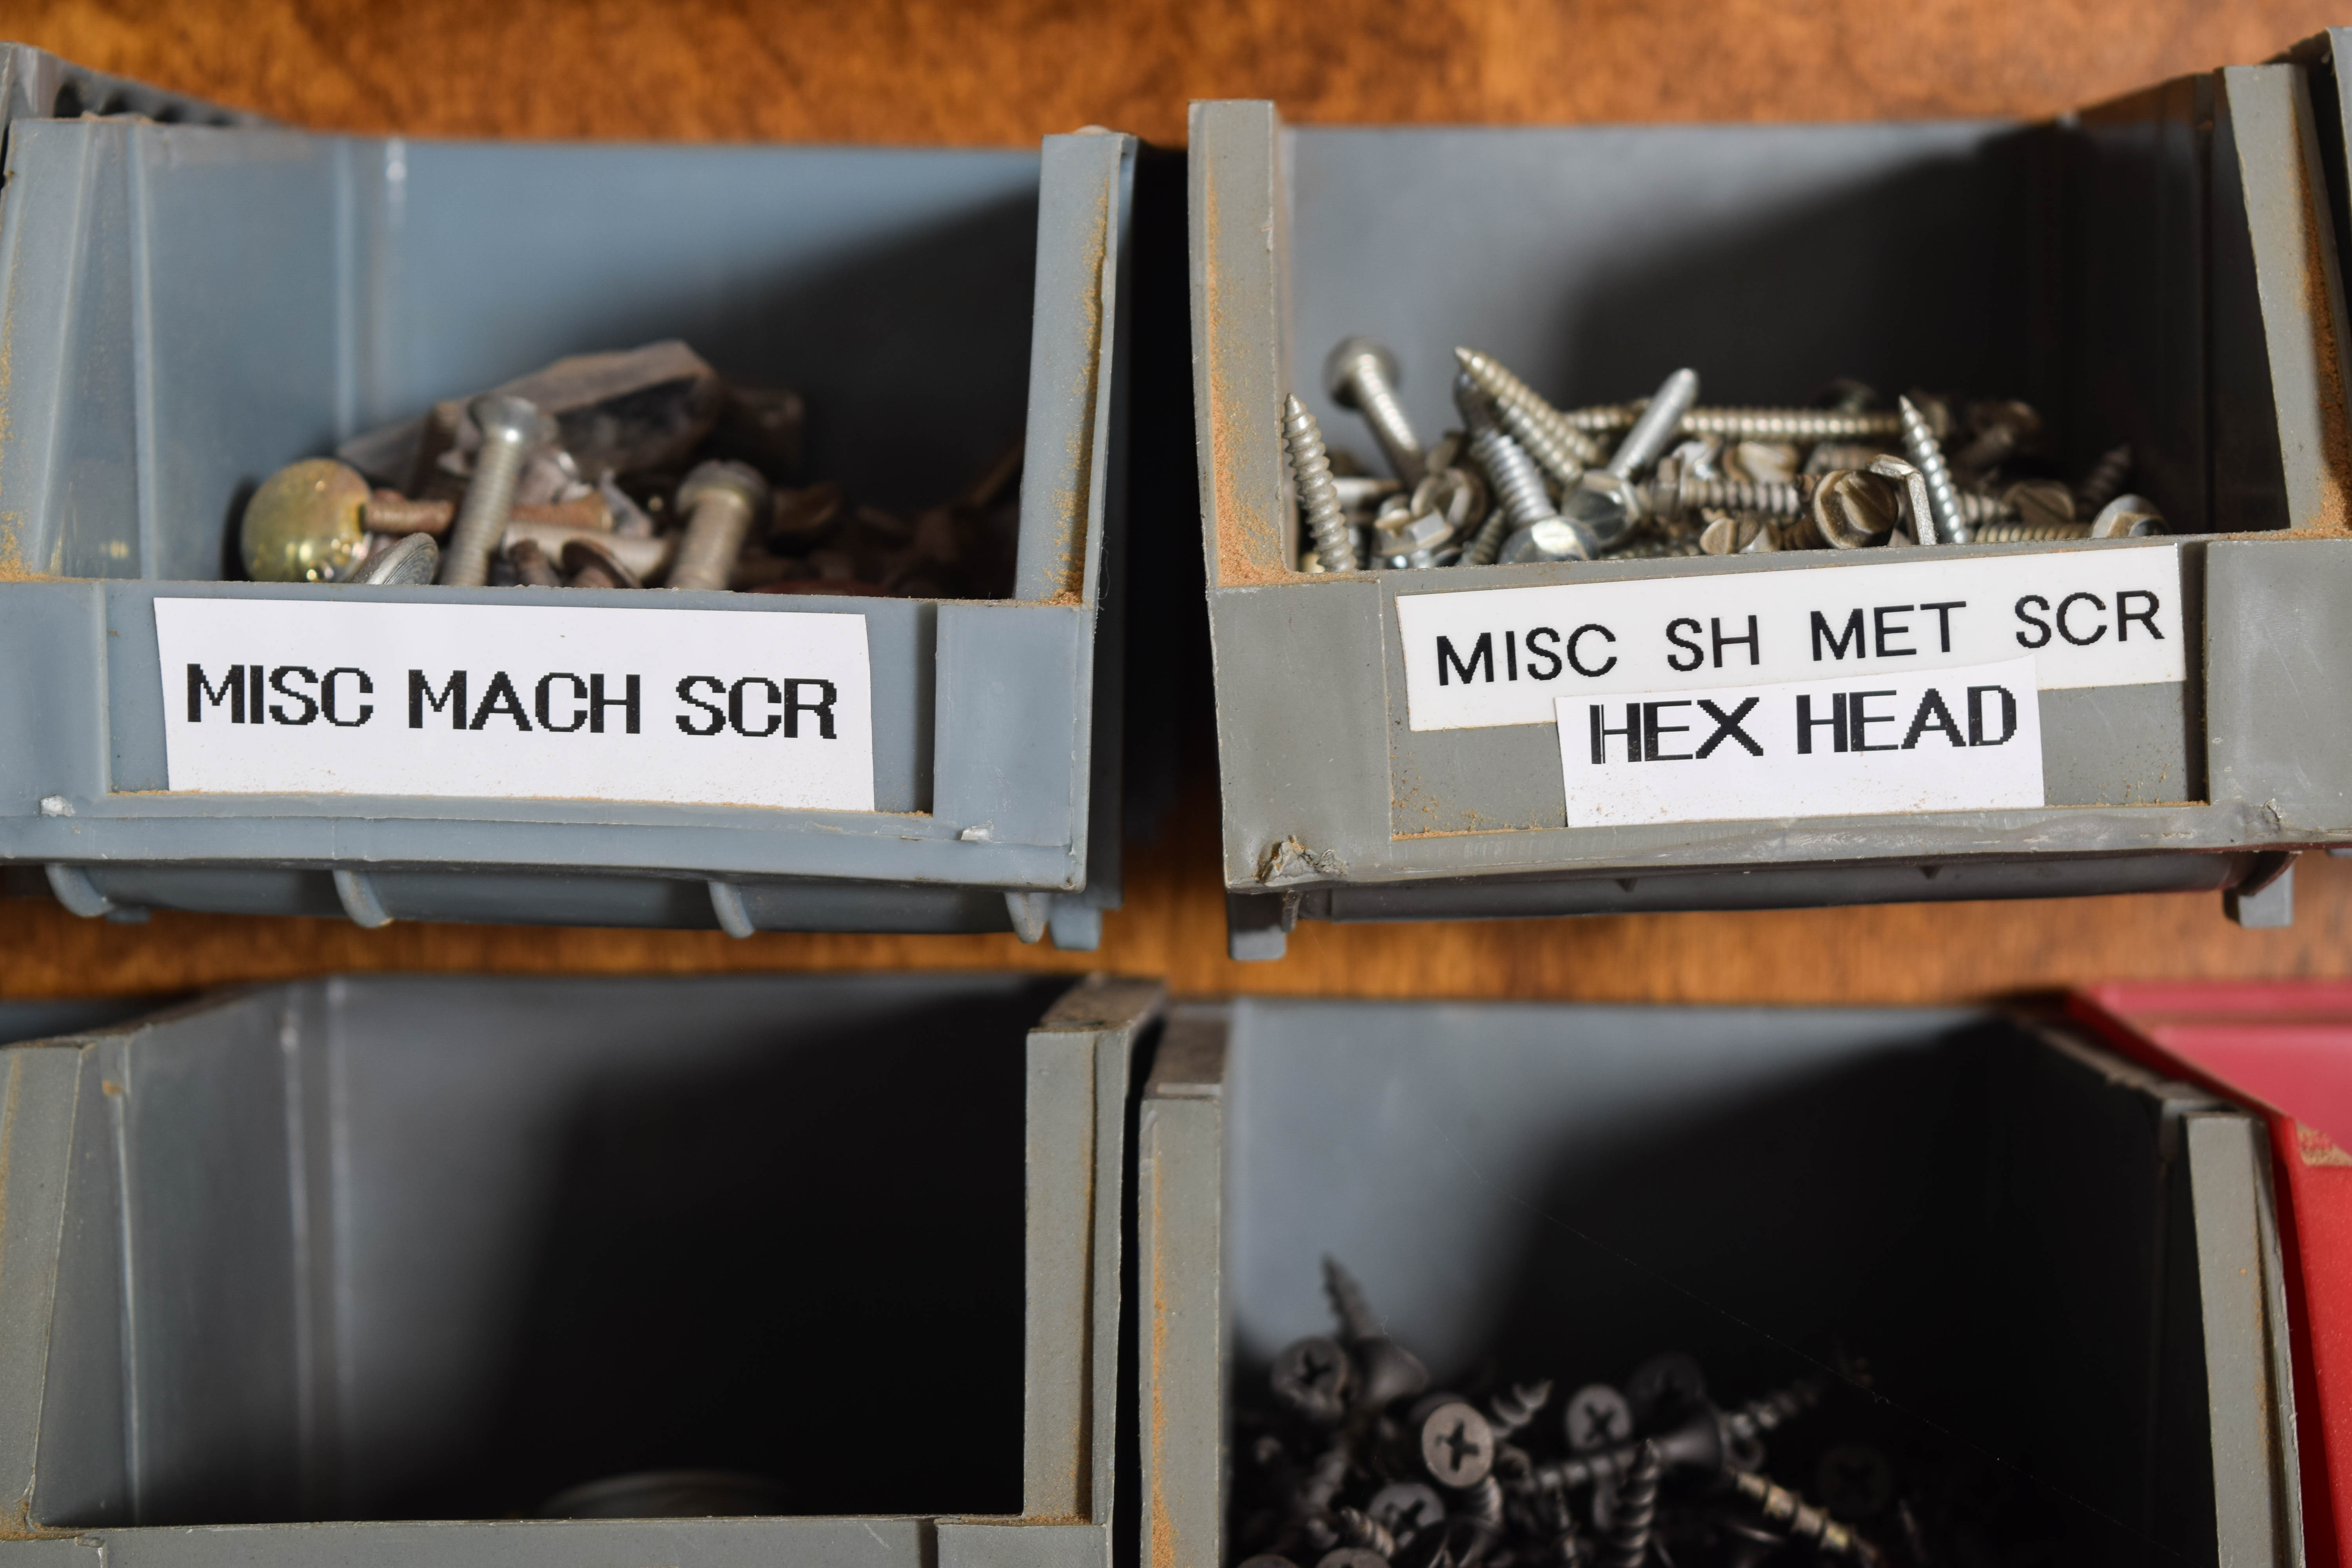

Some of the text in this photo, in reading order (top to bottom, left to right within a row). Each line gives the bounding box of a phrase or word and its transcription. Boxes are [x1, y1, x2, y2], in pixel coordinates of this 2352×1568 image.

[1437, 590, 2165, 686] MISC SH MET SCR
[187, 664, 838, 739] MISC MACH SCR
[1590, 686, 2017, 764] HEX HEAD
